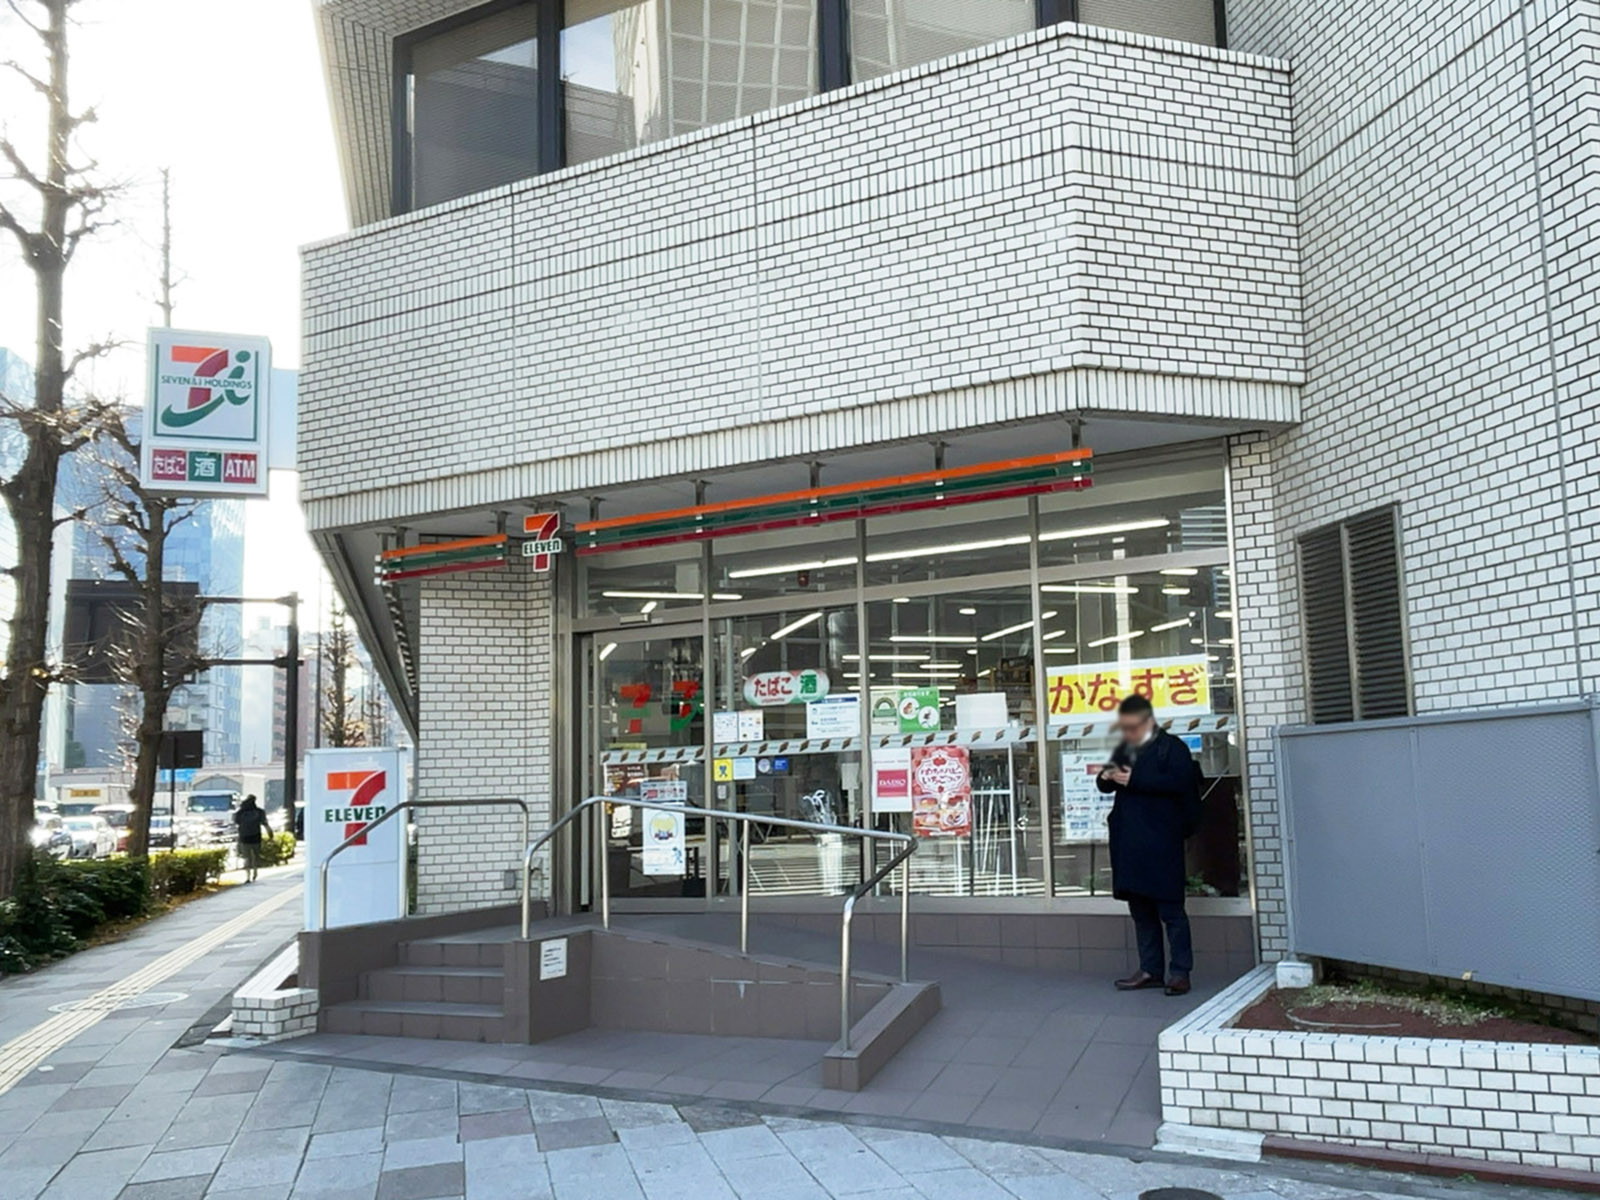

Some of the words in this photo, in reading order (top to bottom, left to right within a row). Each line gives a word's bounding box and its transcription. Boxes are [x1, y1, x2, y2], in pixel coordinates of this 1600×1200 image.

[204, 379, 252, 389] HOLDINGS
[153, 456, 186, 475] たばこ
[194, 457, 217, 477] 酒
[225, 459, 255, 479] ATM
[754, 676, 793, 697] たばこ
[800, 674, 817, 694] 酒
[1049, 665, 1204, 715] かなすぎ
